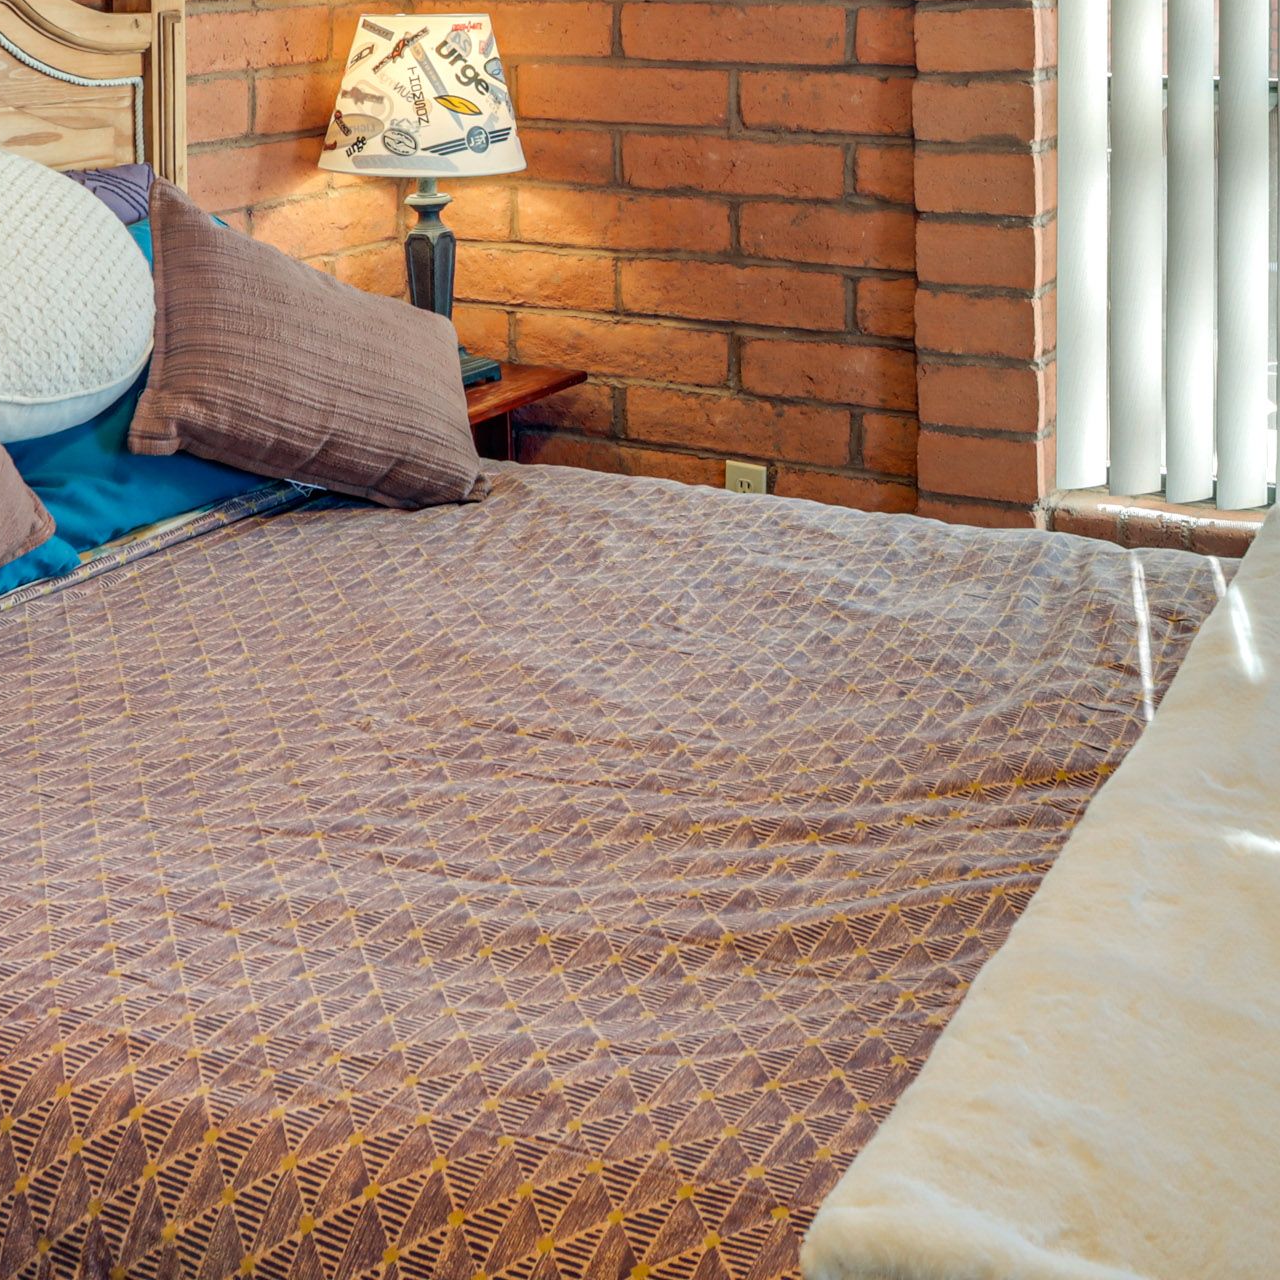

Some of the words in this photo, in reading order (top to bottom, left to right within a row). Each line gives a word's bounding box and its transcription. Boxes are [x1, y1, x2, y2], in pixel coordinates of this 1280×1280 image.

[407, 66, 430, 126] THOMSON
[435, 40, 489, 96] urge
[345, 136, 367, 158] urge
